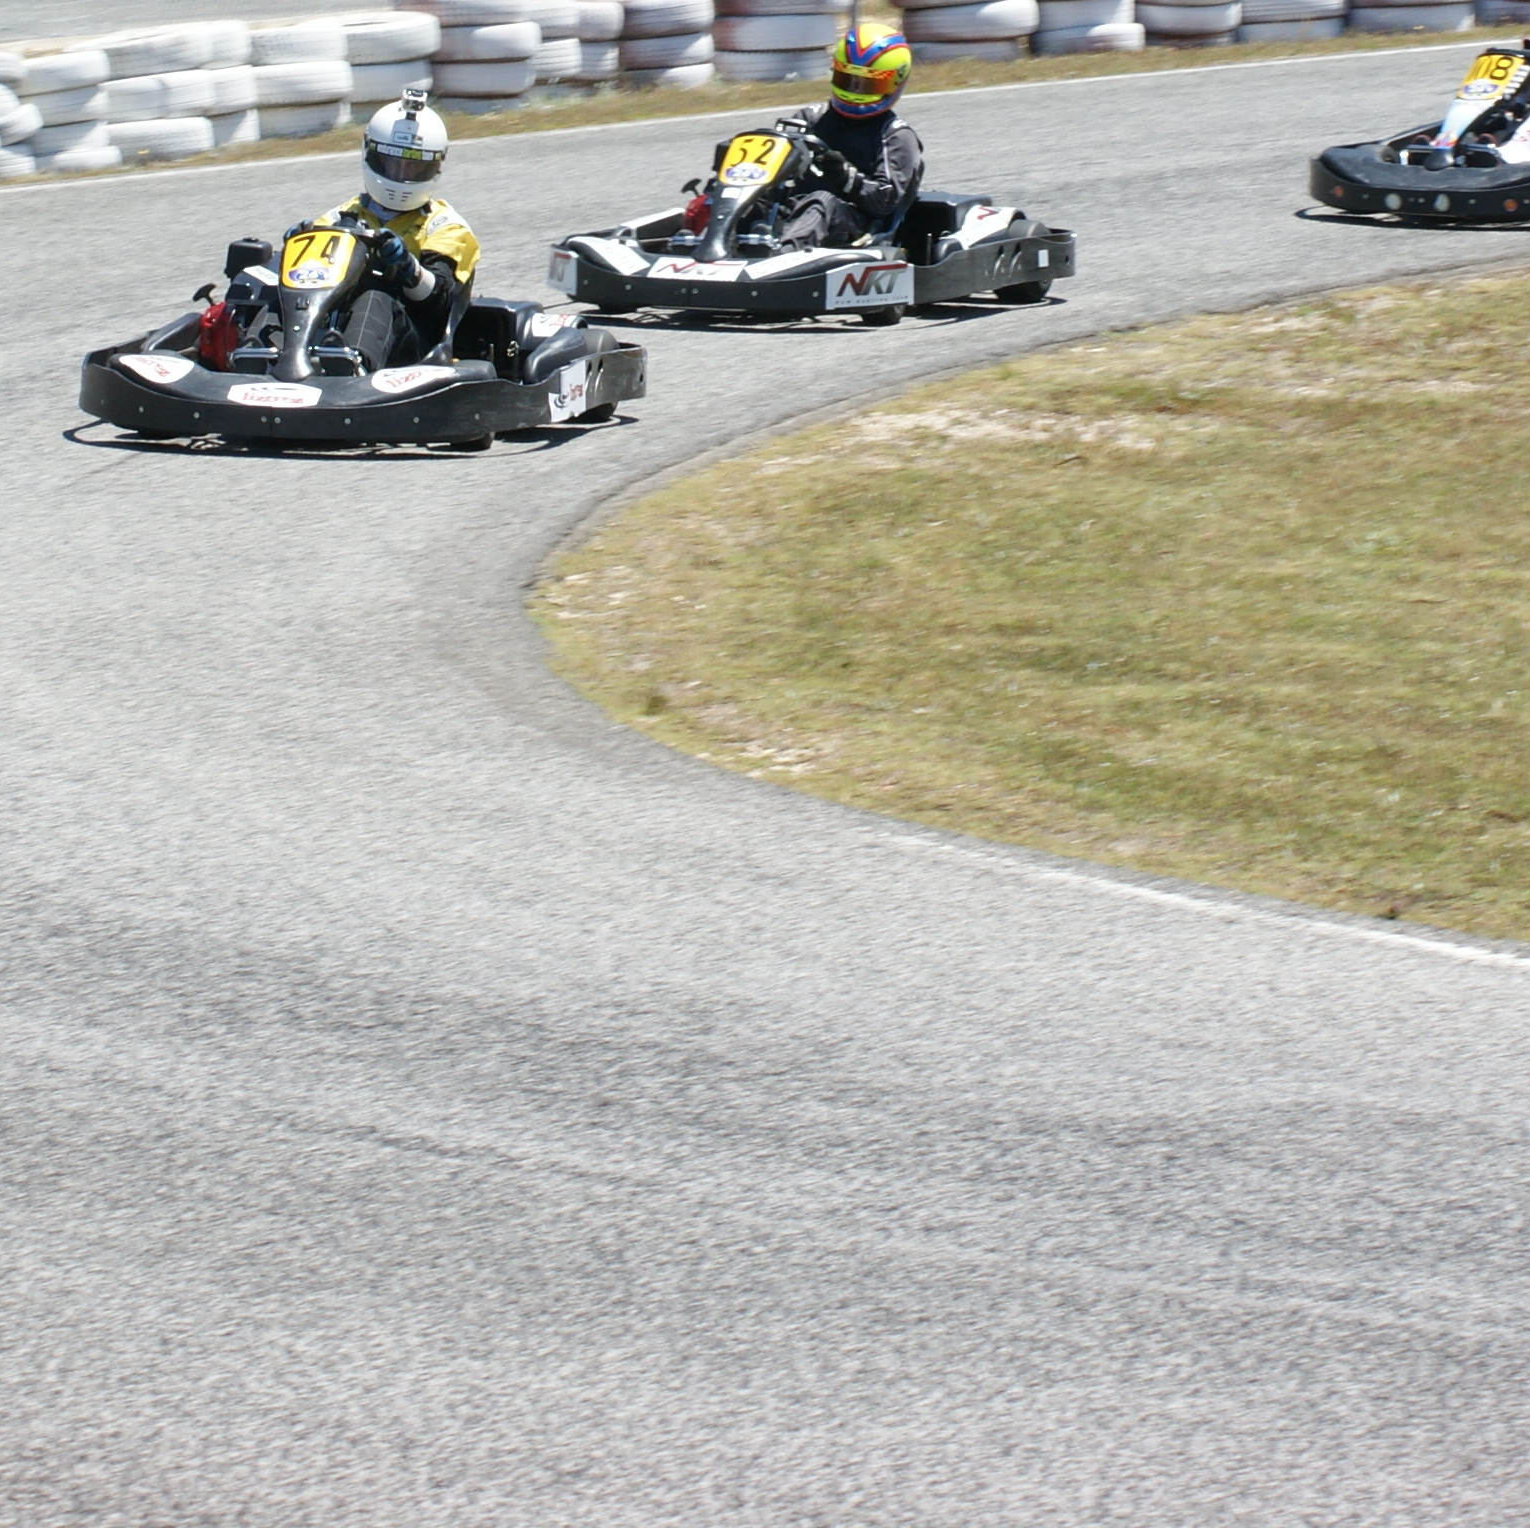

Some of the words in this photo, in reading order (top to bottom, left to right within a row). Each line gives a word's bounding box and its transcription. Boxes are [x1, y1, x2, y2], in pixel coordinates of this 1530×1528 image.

[730, 138, 776, 167] 52
[290, 234, 342, 268] 74
[836, 262, 908, 297] NKT
